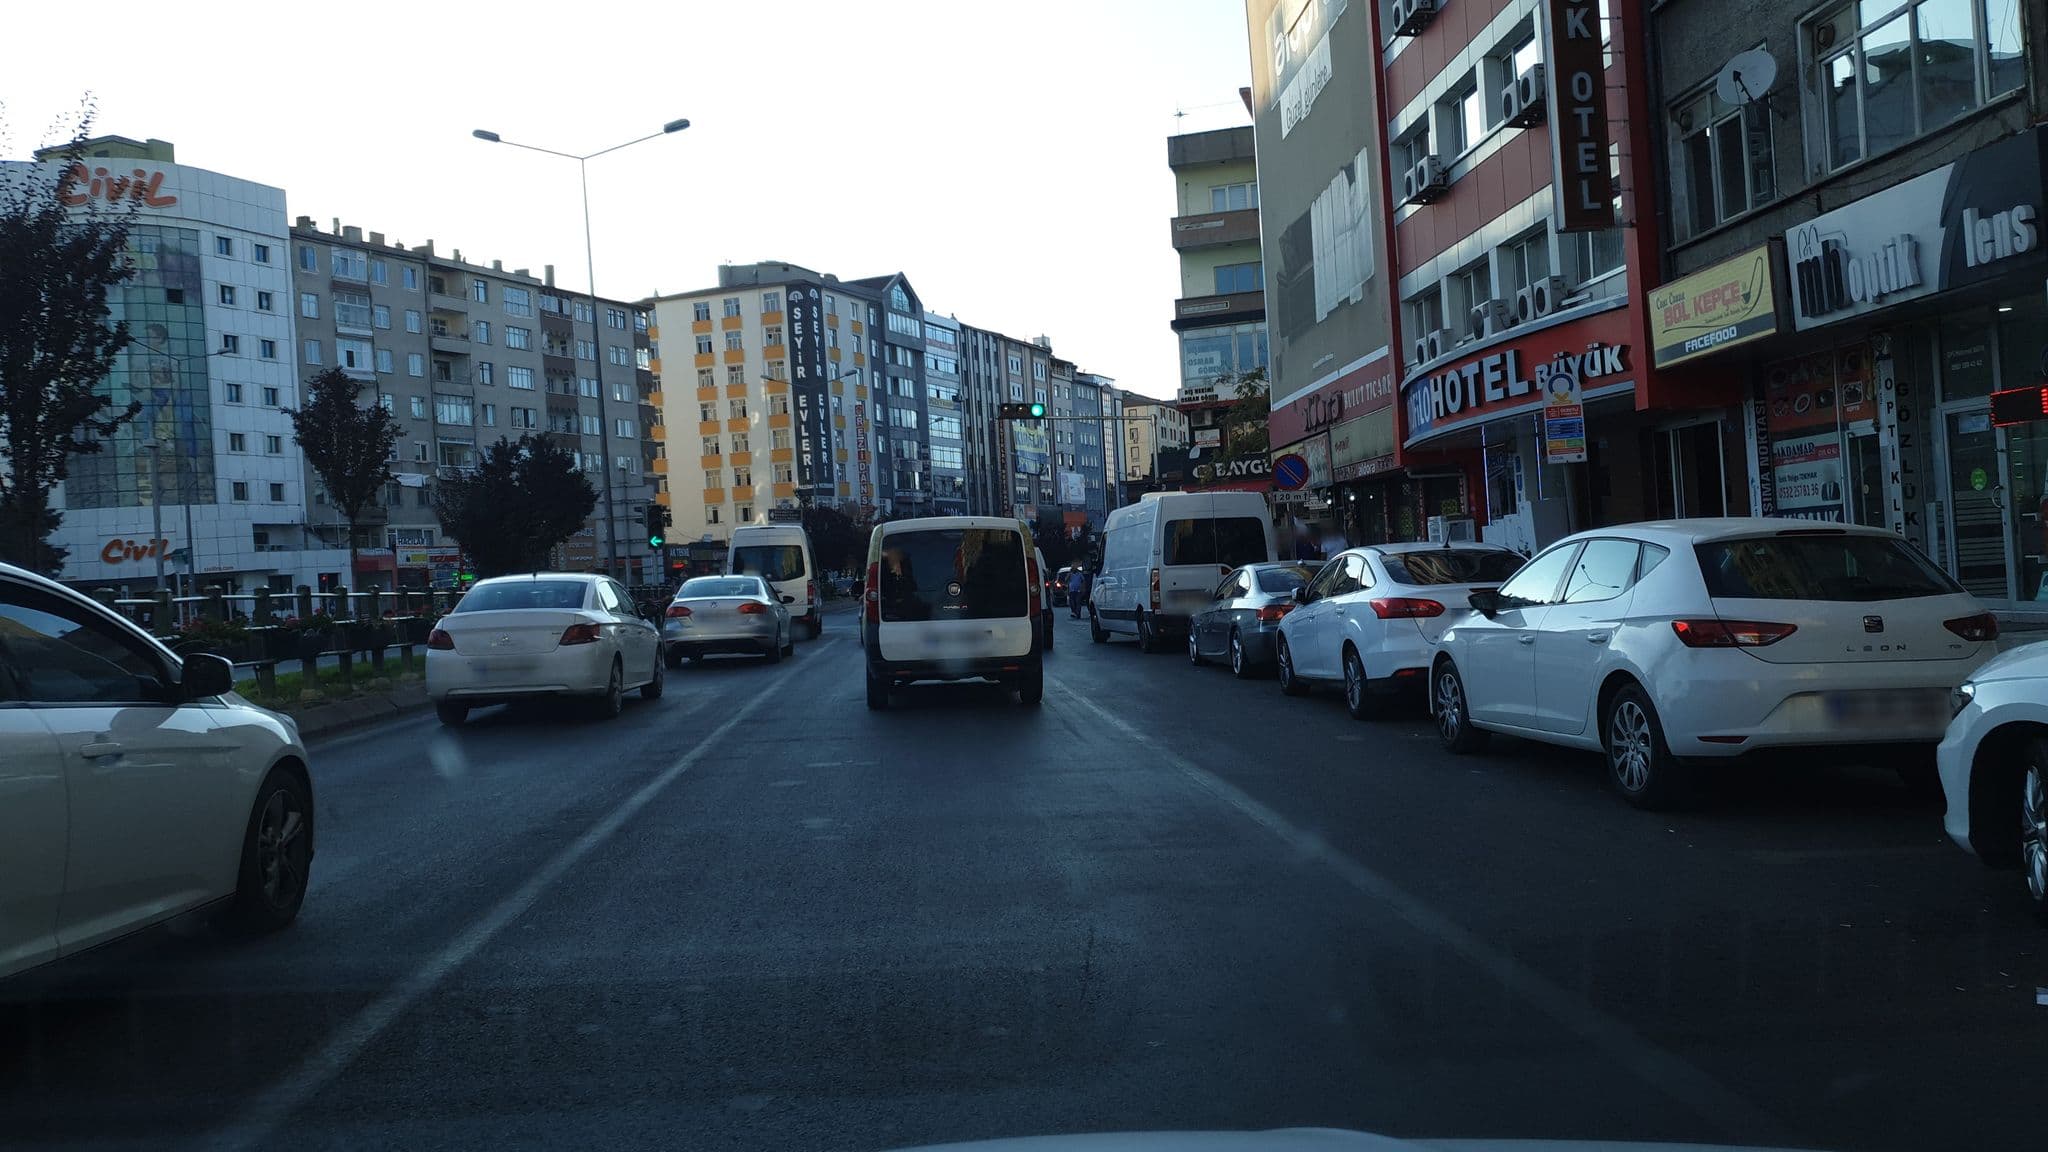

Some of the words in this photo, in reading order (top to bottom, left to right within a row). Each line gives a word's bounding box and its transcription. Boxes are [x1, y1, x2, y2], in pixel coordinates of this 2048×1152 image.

[1566, 0, 1592, 39] K
[1571, 71, 1602, 210] OTEL
[1849, 234, 1921, 304] optik
[1963, 204, 2038, 268] lens
[793, 306, 806, 379] SEYİR
[1663, 301, 1690, 328] BOL
[1685, 326, 1737, 353] FACEFOOD
[812, 305, 822, 377] SEYİR
[818, 393, 828, 479] EVLERİ
[1429, 349, 1529, 419] HOTEL
[1535, 343, 1627, 391] BÜYÜK
[799, 395, 812, 481] EVLERİ
[1895, 382, 1919, 547] GÖZLÜK
[1279, 493, 1290, 501] 20
[1846, 644, 1907, 652] LEON
